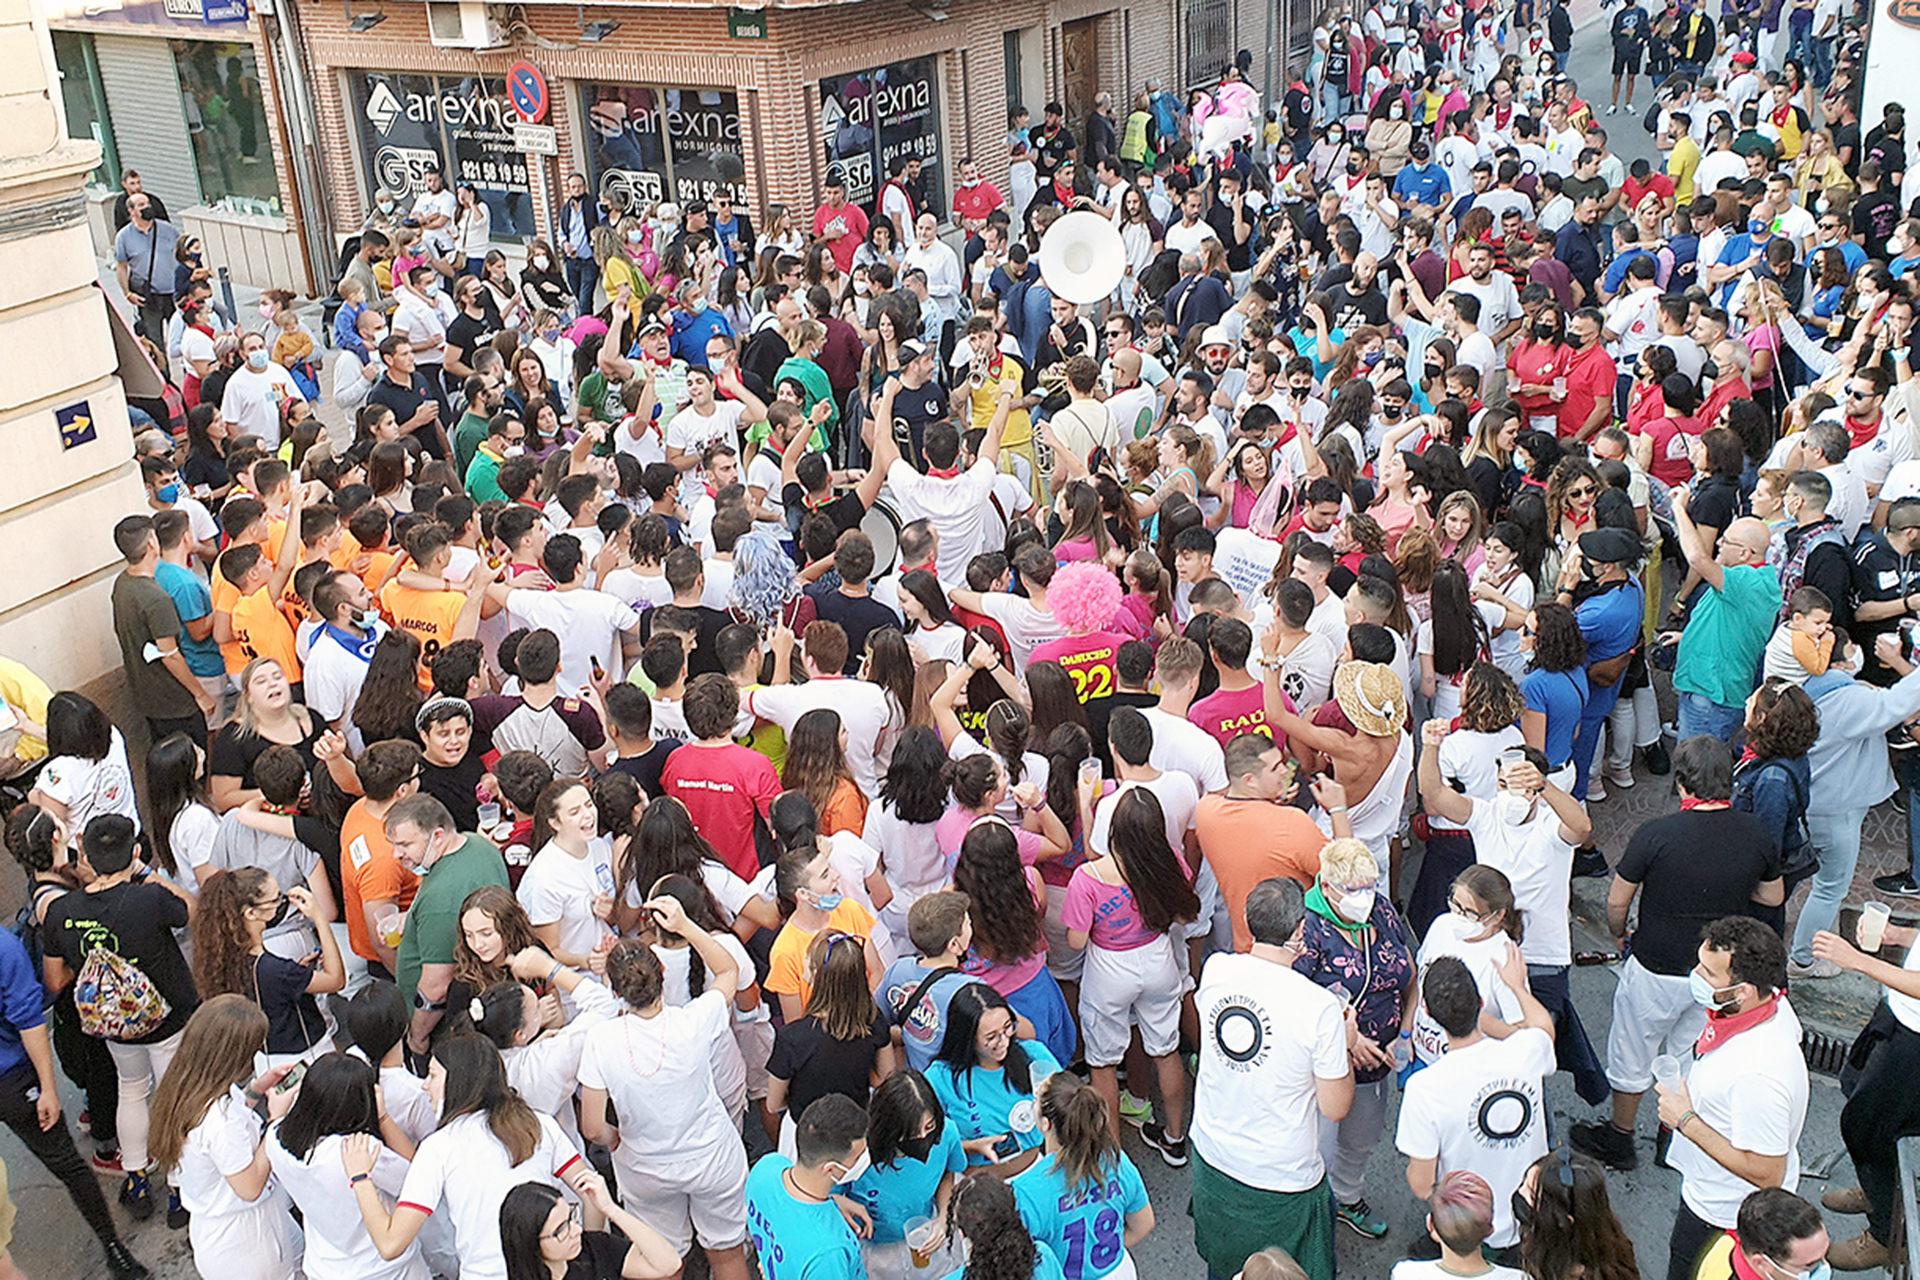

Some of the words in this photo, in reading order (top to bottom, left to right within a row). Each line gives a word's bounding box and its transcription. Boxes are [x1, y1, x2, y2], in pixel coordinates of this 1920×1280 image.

[406, 93, 521, 128] arexna
[849, 80, 930, 125] arexna
[633, 108, 741, 139] arexna
[461, 160, 481, 181] 921
[483, 161, 498, 182] 58
[499, 163, 512, 183] 19
[512, 164, 527, 185] 59
[401, 618, 438, 634] MARCOS
[1069, 664, 1113, 705] 22
[654, 727, 689, 739] NAVA
[1221, 709, 1266, 733] RAÚ
[1062, 1208, 1121, 1279] 18
